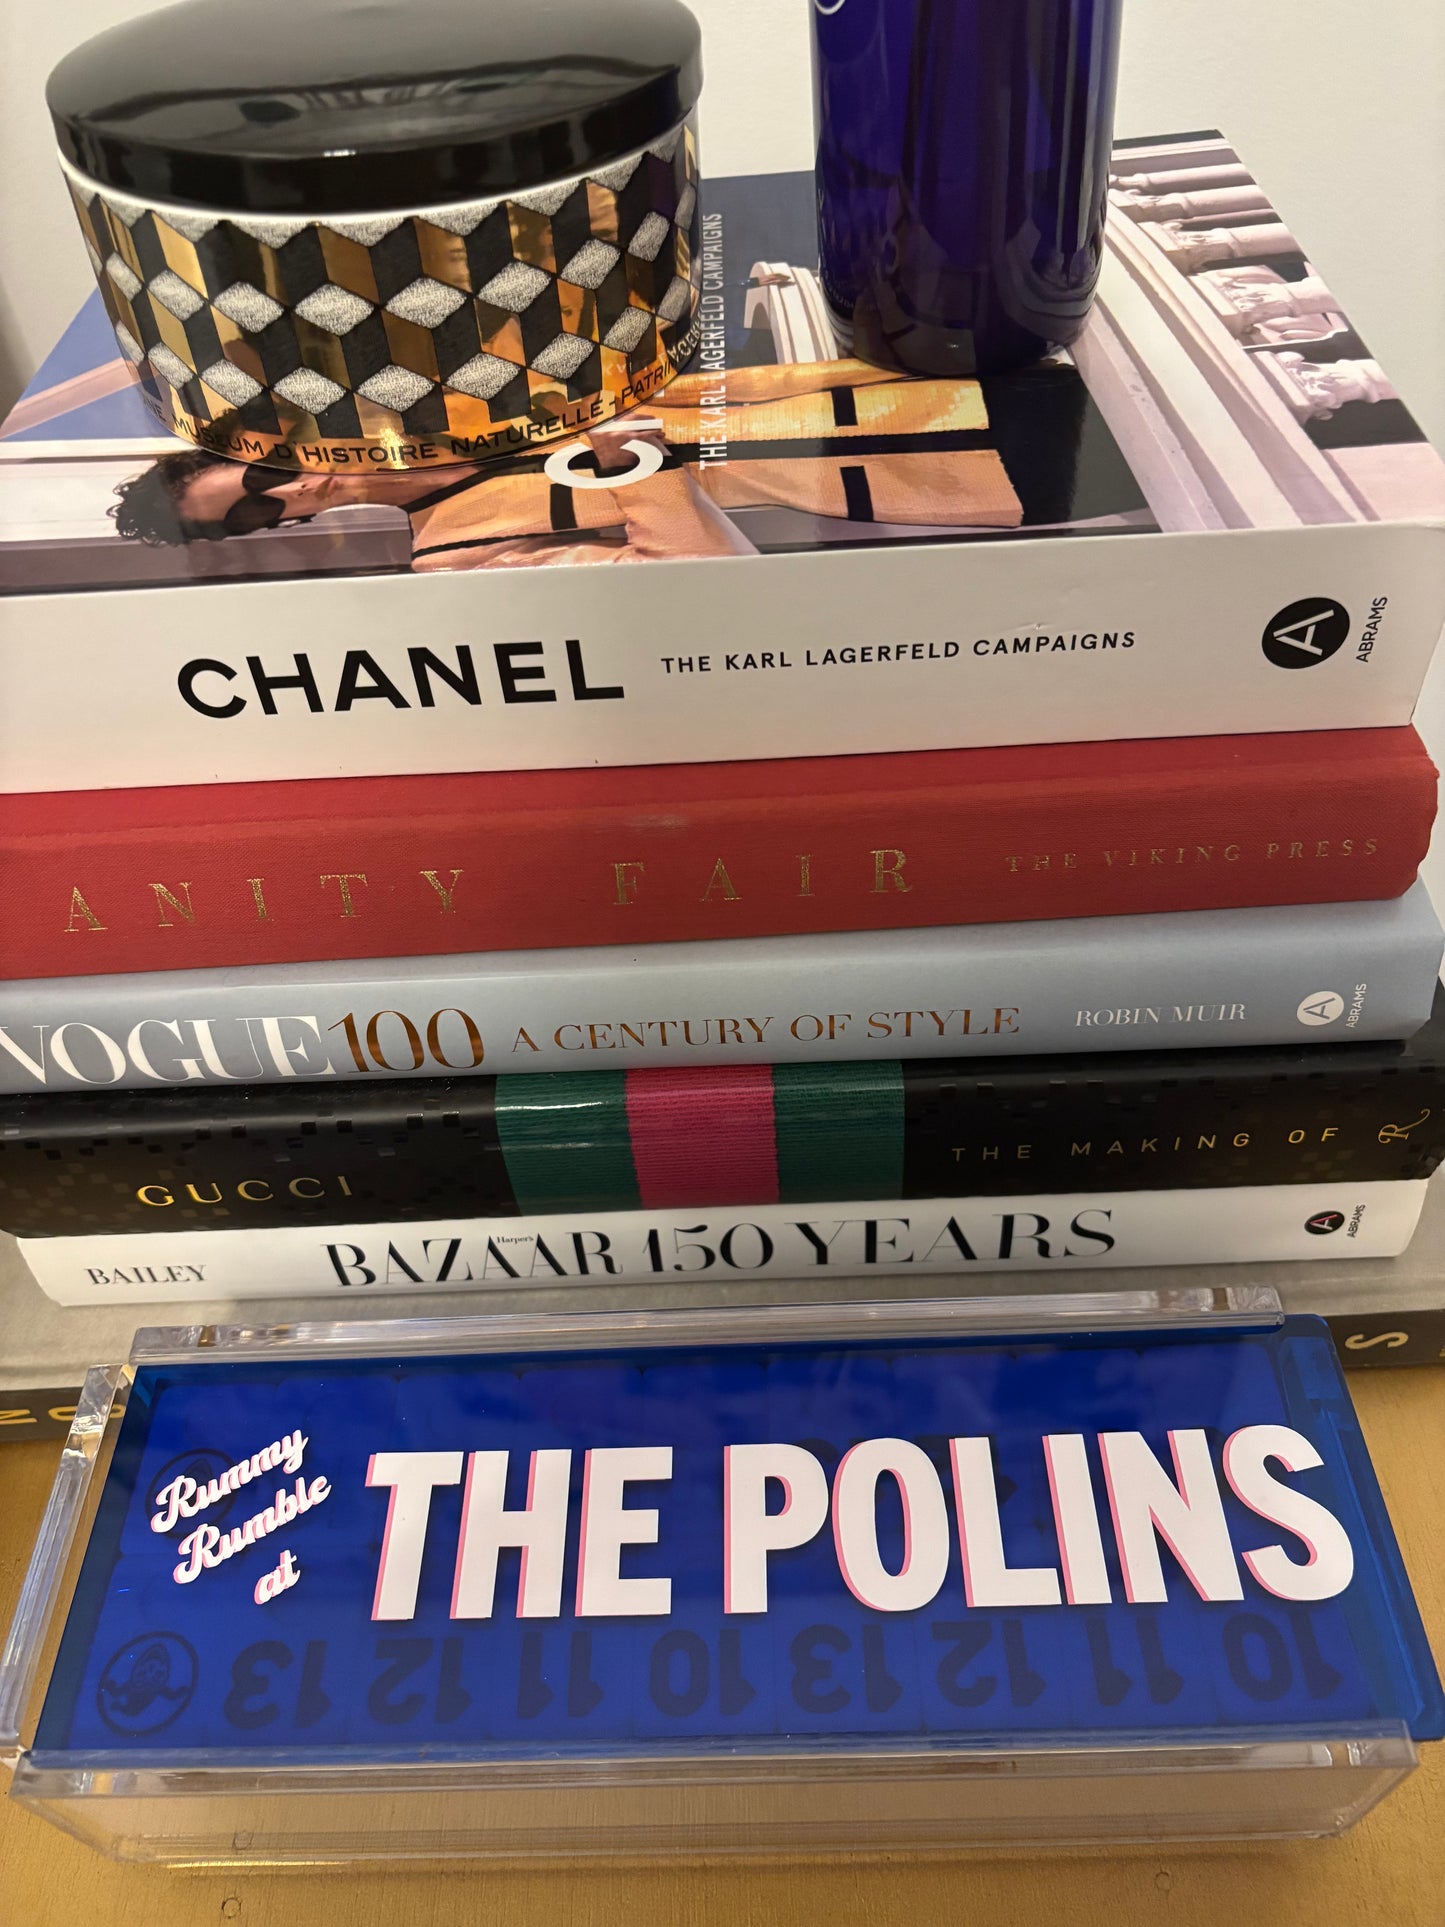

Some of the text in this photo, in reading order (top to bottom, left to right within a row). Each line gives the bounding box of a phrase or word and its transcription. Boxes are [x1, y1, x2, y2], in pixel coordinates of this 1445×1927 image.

[699, 213, 727, 470] THE KARL LAGERFELD CAMPAIGNS
[451, 399, 604, 455] NATURELLE
[1355, 596, 1388, 662] ABRAMS
[177, 631, 1136, 719] CHANEL THE KARL LAGERFELD CAMPAIGNS
[1005, 837, 1379, 872] THE VIKING PRESS
[64, 849, 913, 933] ANITY FAIR
[511, 1026, 541, 1053] A
[553, 1016, 774, 1051] CENTURY
[790, 1013, 852, 1042] OF
[866, 1007, 1021, 1040] STYLE
[1075, 1003, 1246, 1027] ROBIN MUIR
[1345, 983, 1368, 1028] ABRAMS
[951, 1127, 1340, 1163] THE MAKING OF
[136, 1175, 353, 1207] GUCCI
[320, 1208, 1116, 1287] BAZAAR 150 YEARS
[496, 1234, 534, 1246] Harper's
[1346, 1203, 1366, 1238] ABRAMS
[84, 1264, 207, 1285] BAILEY
[151, 1429, 309, 1533] Rummy
[173, 1475, 332, 1585] Rumble
[365, 1424, 1354, 1622] THE POLINS
[254, 1549, 301, 1605] at
